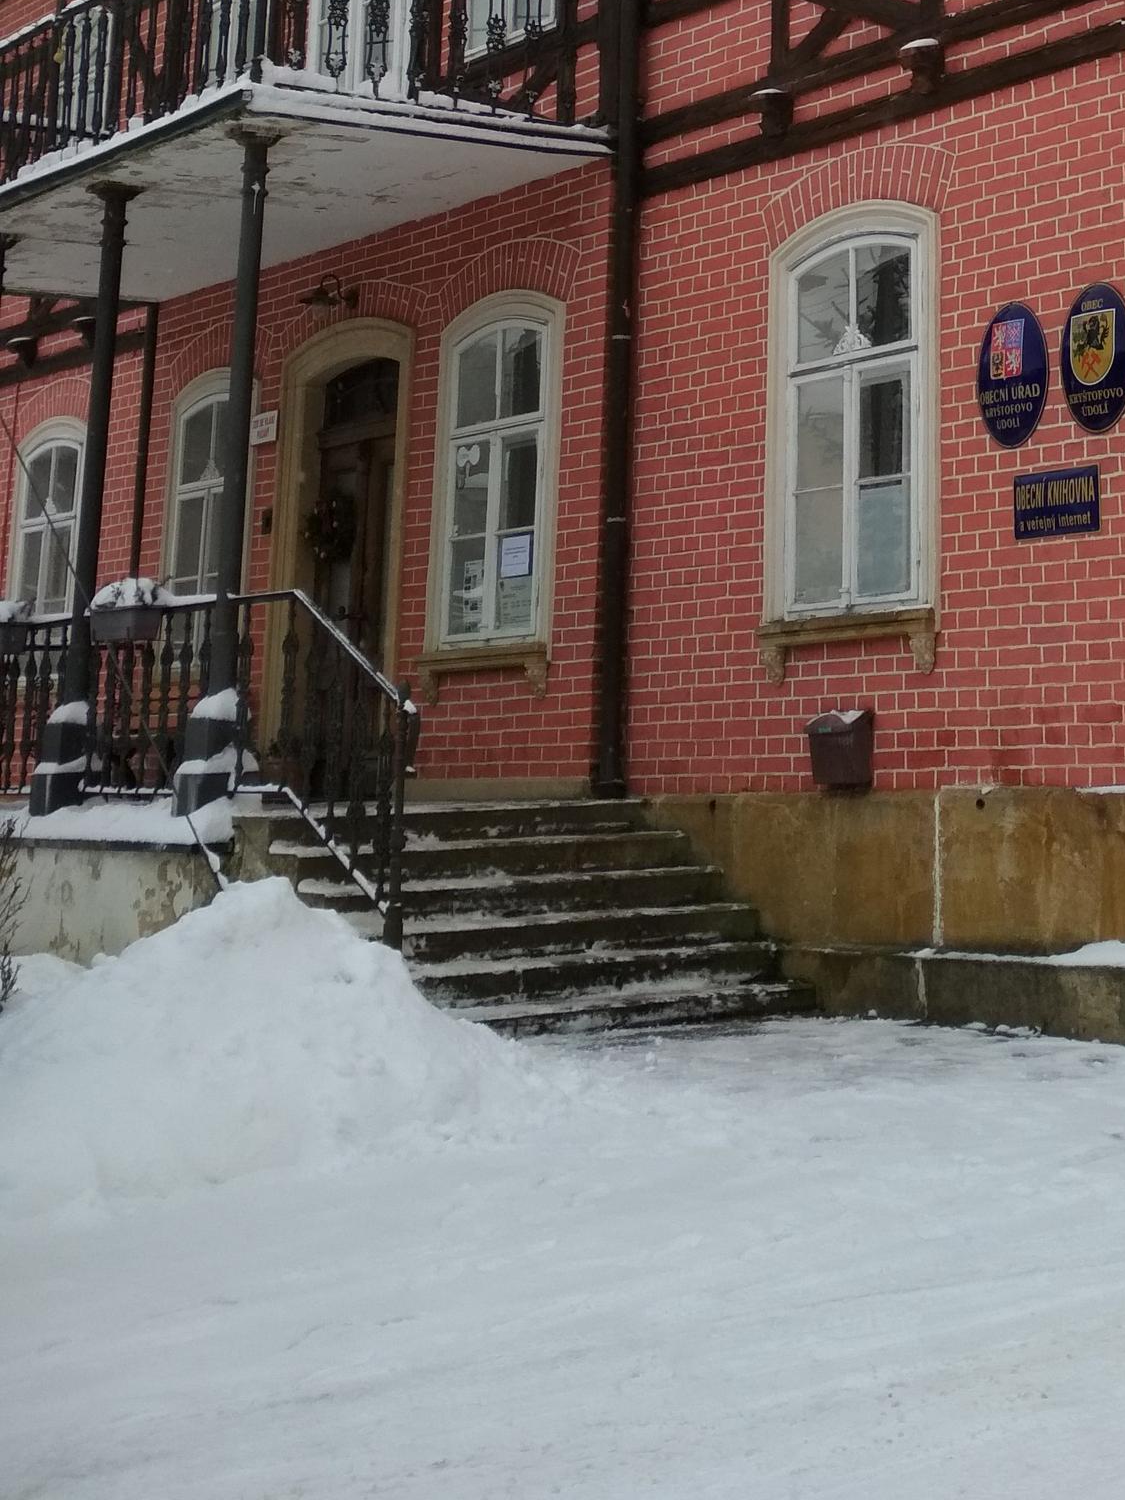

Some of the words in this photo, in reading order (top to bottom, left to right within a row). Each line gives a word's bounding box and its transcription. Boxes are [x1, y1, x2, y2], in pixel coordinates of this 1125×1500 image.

[1081, 299, 1104, 312] OBEC
[980, 385, 1009, 405] OBECNÍ
[1011, 382, 1041, 399] ÚŘAD
[1069, 387, 1124, 405] KRYŠTOFOVO
[985, 402, 1033, 418] KRYŠTOFOVO
[1082, 402, 1109, 417] ÚDOLÍ
[997, 417, 1020, 430] ÚDOLÍ
[1016, 476, 1046, 510] OBECNÍ
[1048, 476, 1095, 506] KNIHOVNA
[1020, 520, 1025, 532] a
[1027, 514, 1055, 531] veřejný
[1058, 511, 1090, 527] internet
